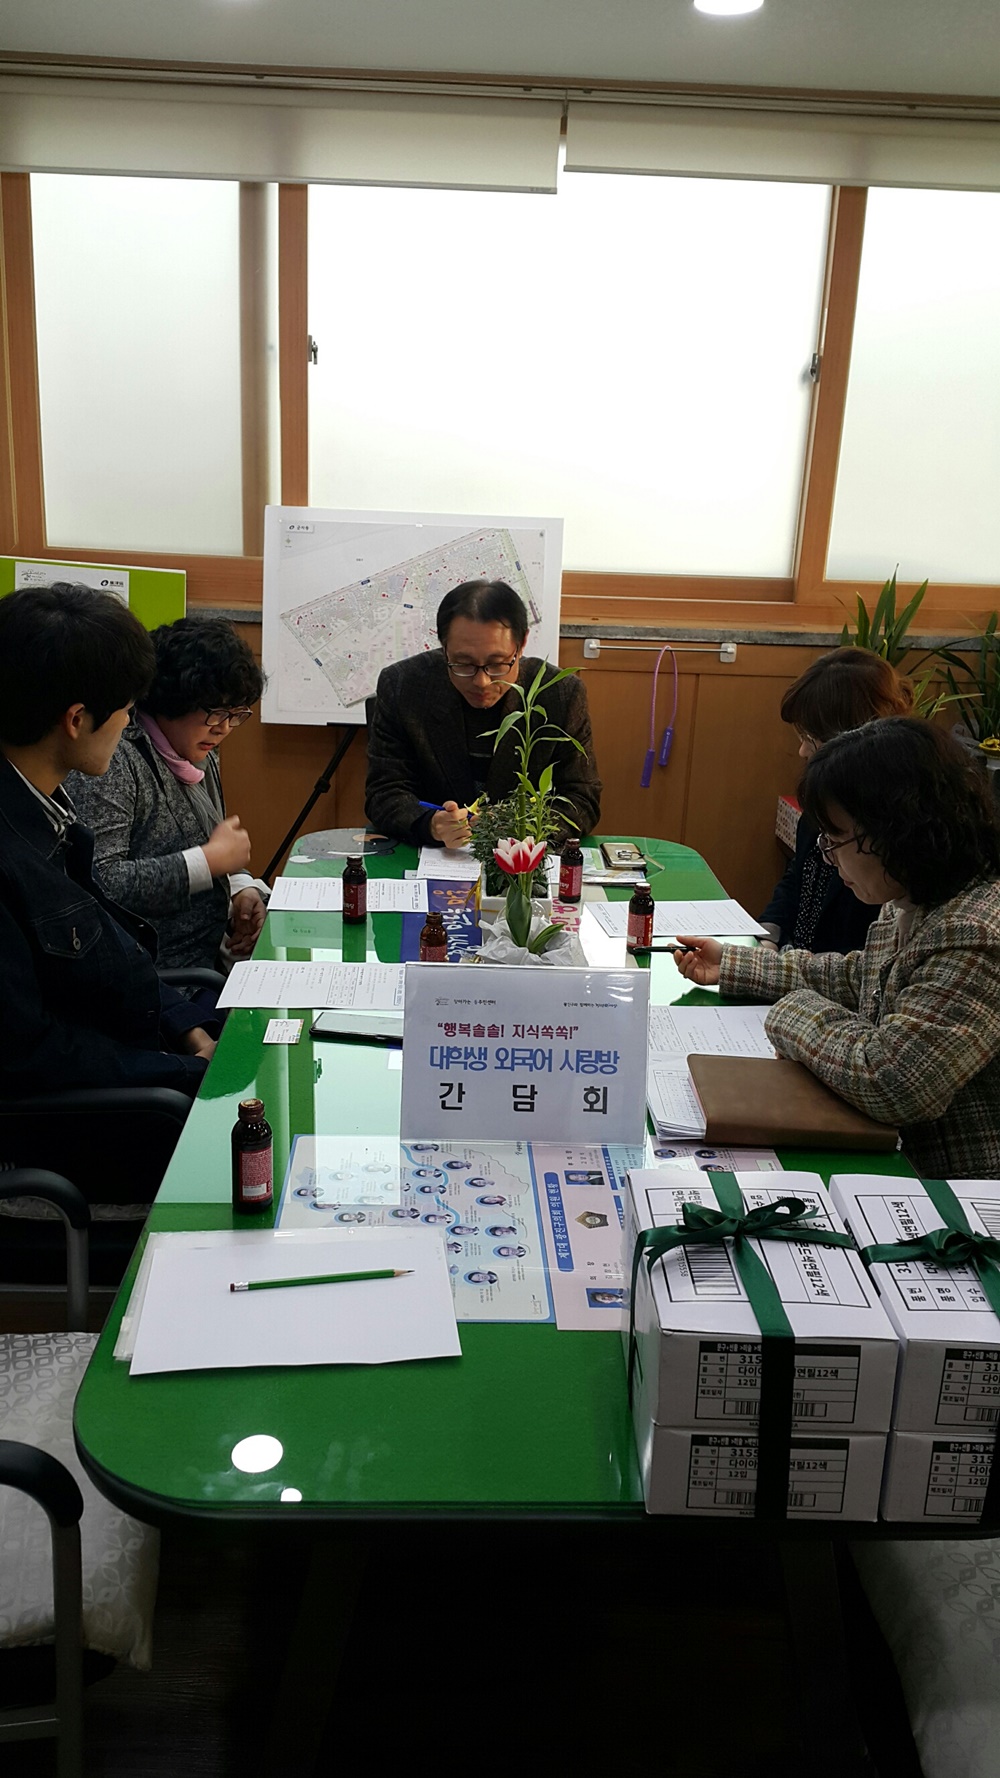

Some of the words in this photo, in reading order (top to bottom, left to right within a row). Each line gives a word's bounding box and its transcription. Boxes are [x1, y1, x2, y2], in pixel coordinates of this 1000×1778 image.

[429, 1045, 488, 1072] 대학생
[494, 1047, 553, 1073] 외국어
[559, 1049, 620, 1075] 사랑방
[438, 1082, 466, 1111] 간
[512, 1084, 538, 1113] 담
[582, 1085, 608, 1115] 회
[549, 1196, 561, 1209] 의원
[551, 1209, 567, 1240] 광진구의회
[557, 1242, 569, 1259] 제7대
